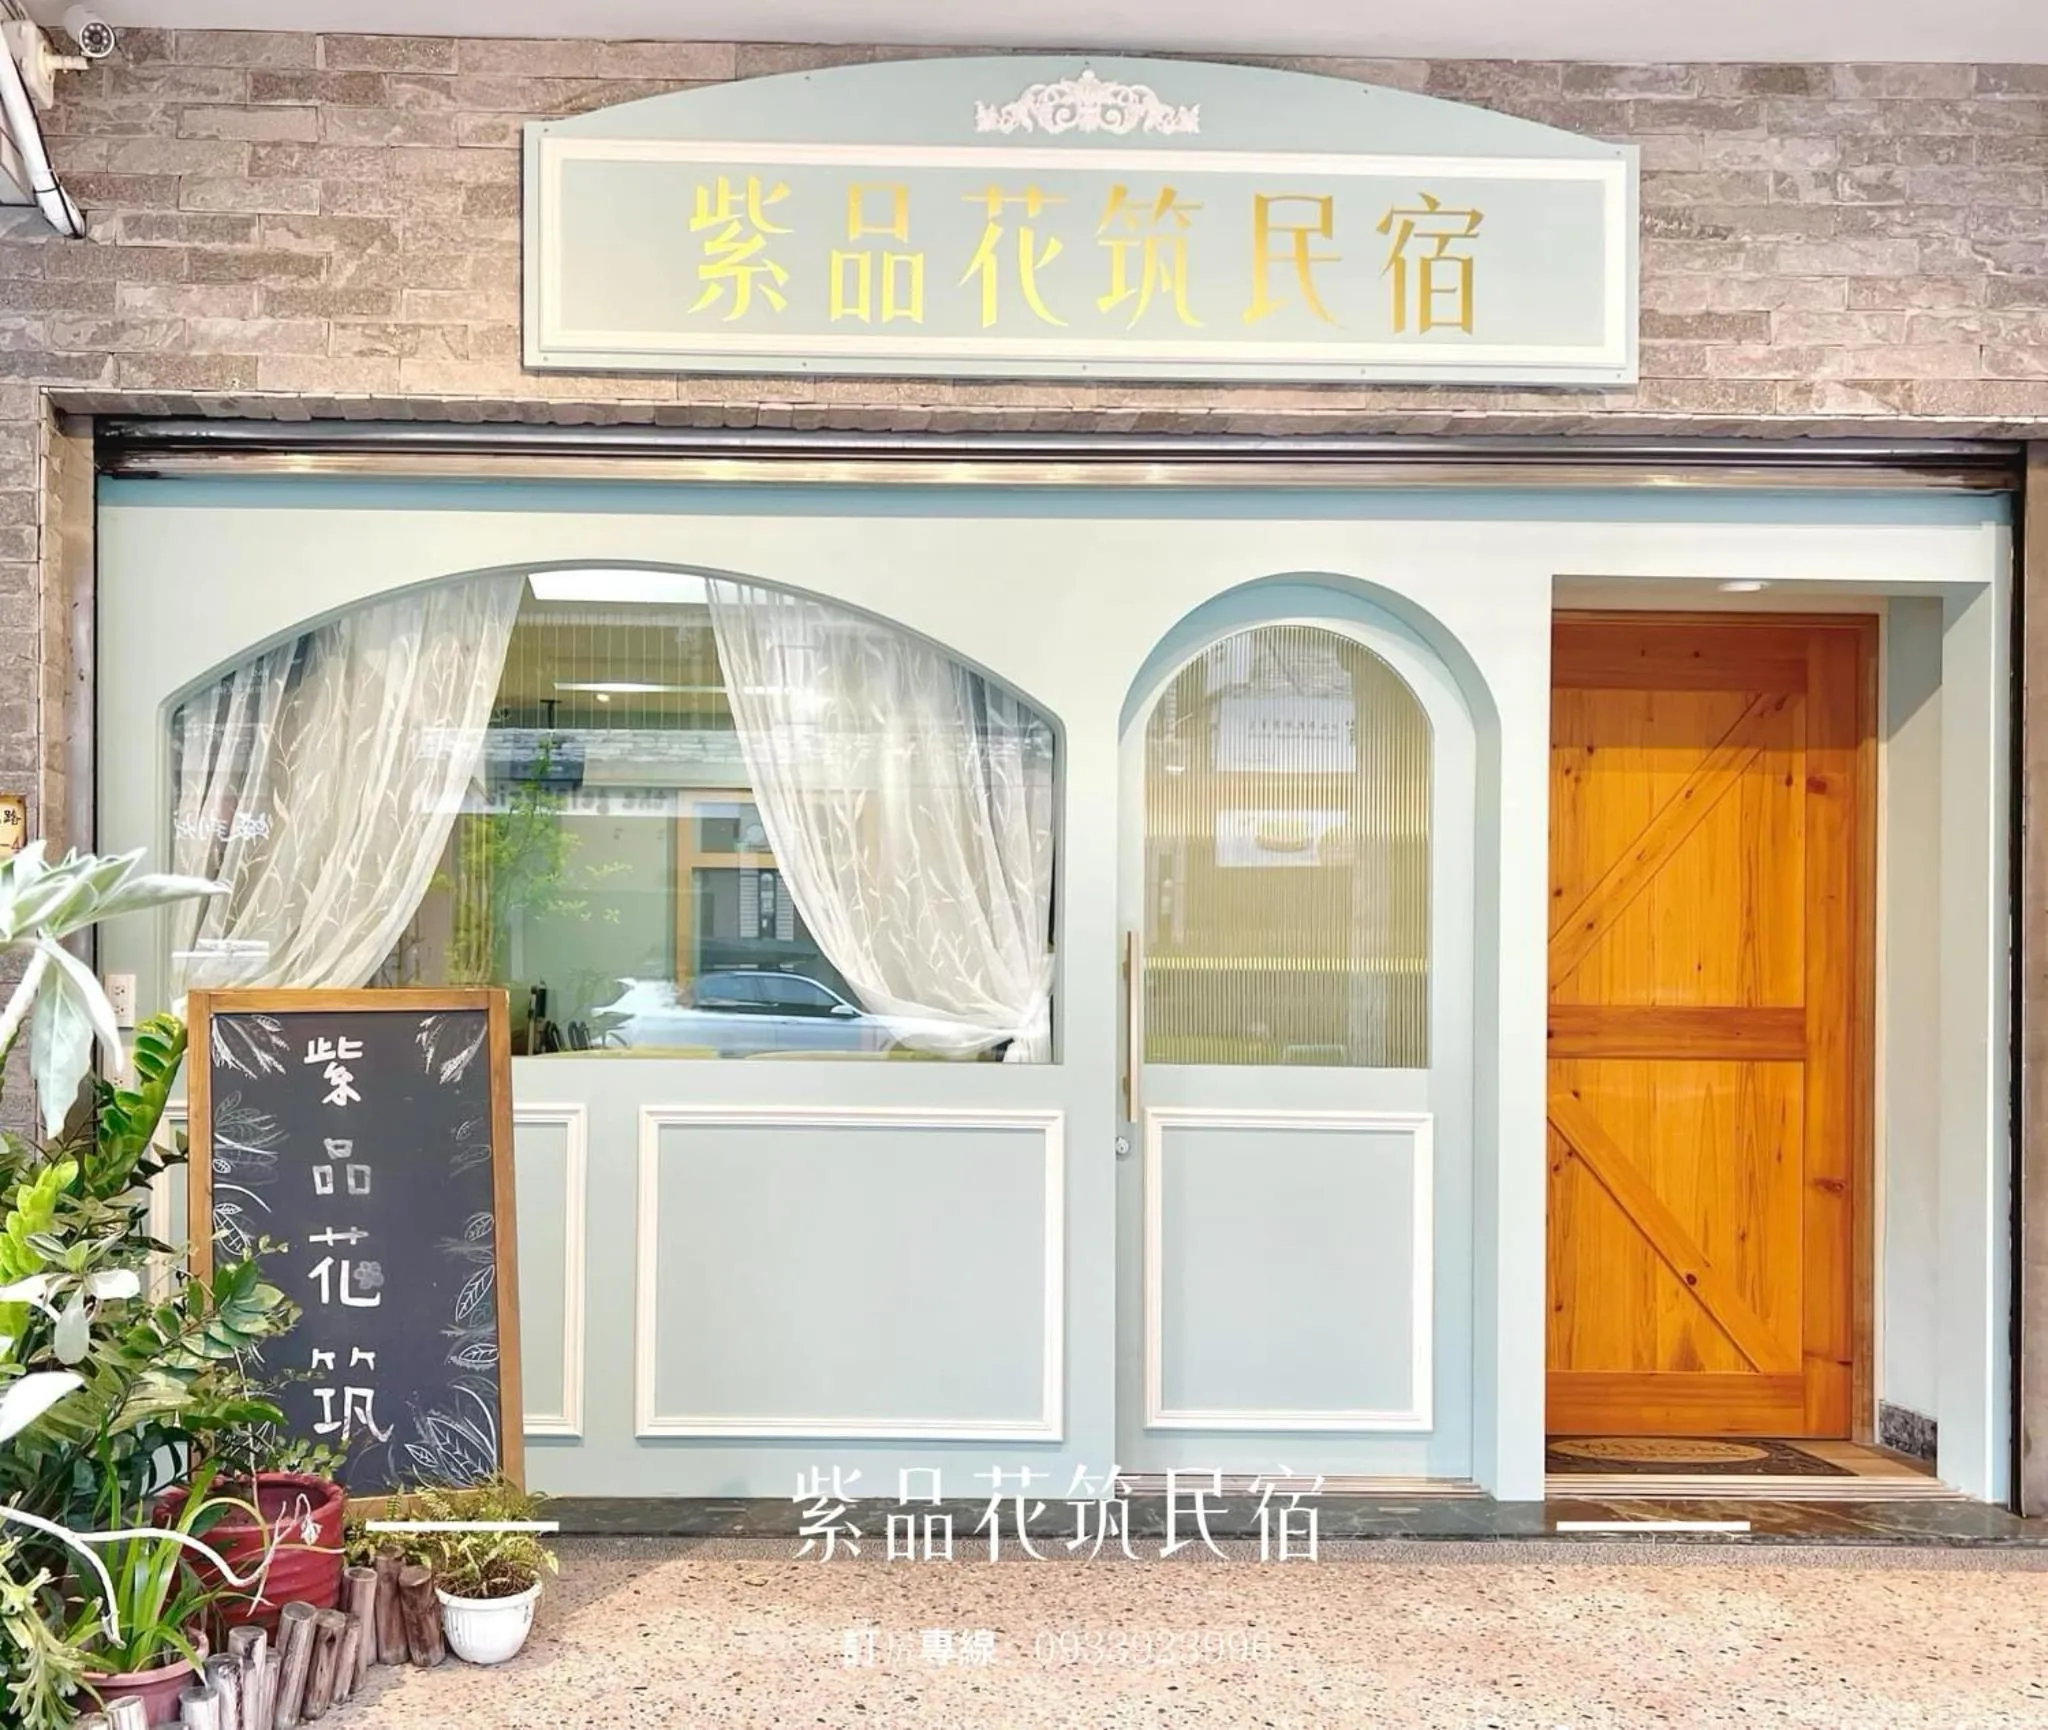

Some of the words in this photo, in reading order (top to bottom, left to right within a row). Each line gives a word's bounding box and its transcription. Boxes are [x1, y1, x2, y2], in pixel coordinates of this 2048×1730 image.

[685, 176, 1486, 335] 紫品花筑民宿
[304, 1036, 393, 1442] 紫品花筑
